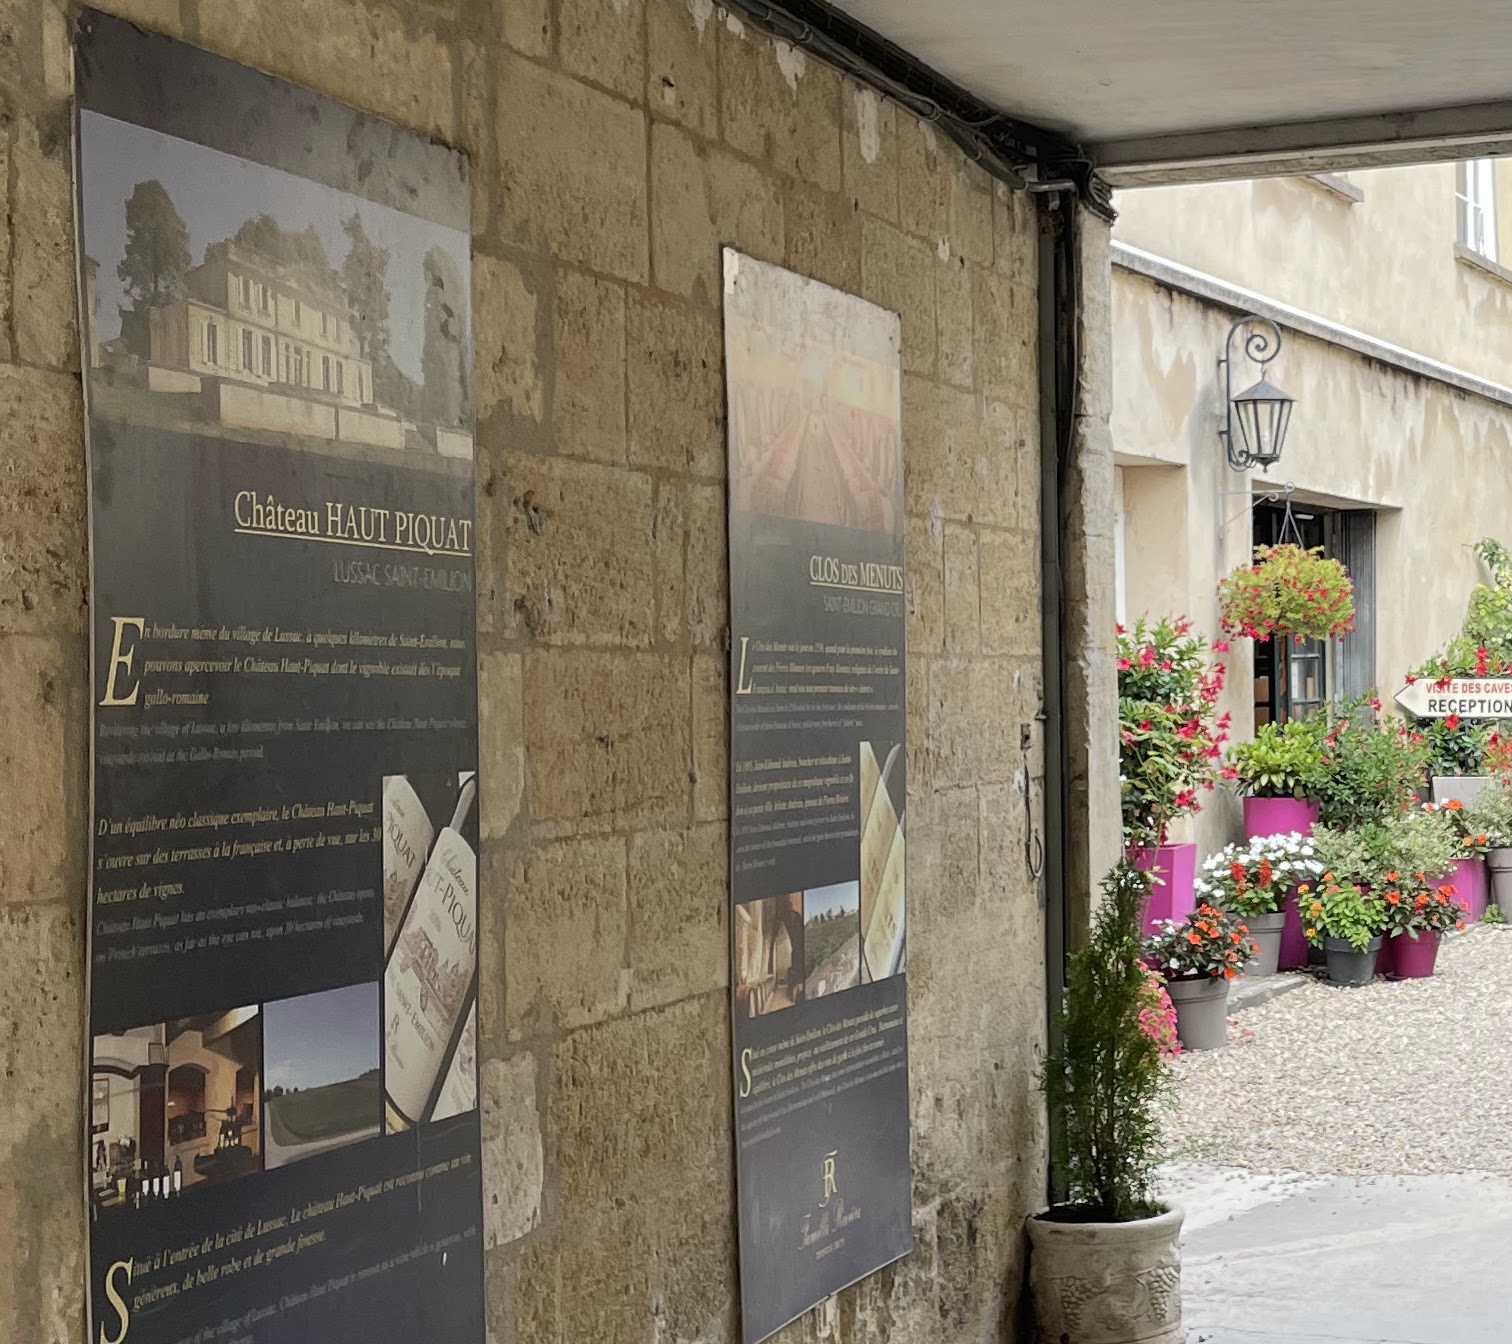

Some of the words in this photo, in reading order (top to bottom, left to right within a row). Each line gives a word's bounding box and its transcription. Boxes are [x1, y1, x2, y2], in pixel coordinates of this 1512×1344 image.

[234, 490, 320, 535] Château
[325, 501, 391, 543] HAUT
[394, 510, 473, 556] PIQUAT
[331, 558, 382, 587] LUSSAC
[809, 555, 841, 584] CLOS
[841, 563, 860, 586] DES
[859, 561, 904, 592] MENUTS
[218, 624, 231, 641] du
[232, 625, 261, 646] village
[262, 626, 274, 643] de
[1460, 681, 1482, 695] DES
[98, 817, 123, 836] D'un
[124, 813, 168, 838] équilibre
[187, 811, 230, 831] classique
[281, 804, 291, 820] le
[135, 852, 153, 867] sur
[152, 846, 170, 865] des
[170, 846, 213, 863] terrasses
[221, 840, 232, 857] la
[96, 887, 138, 905] hectares
[138, 882, 153, 899] de
[201, 1236, 214, 1255] de
[214, 1232, 226, 1250] la
[243, 1221, 256, 1240] de
[182, 1271, 196, 1292] de
[195, 1263, 220, 1287] belle
[252, 1247, 266, 1267] de
